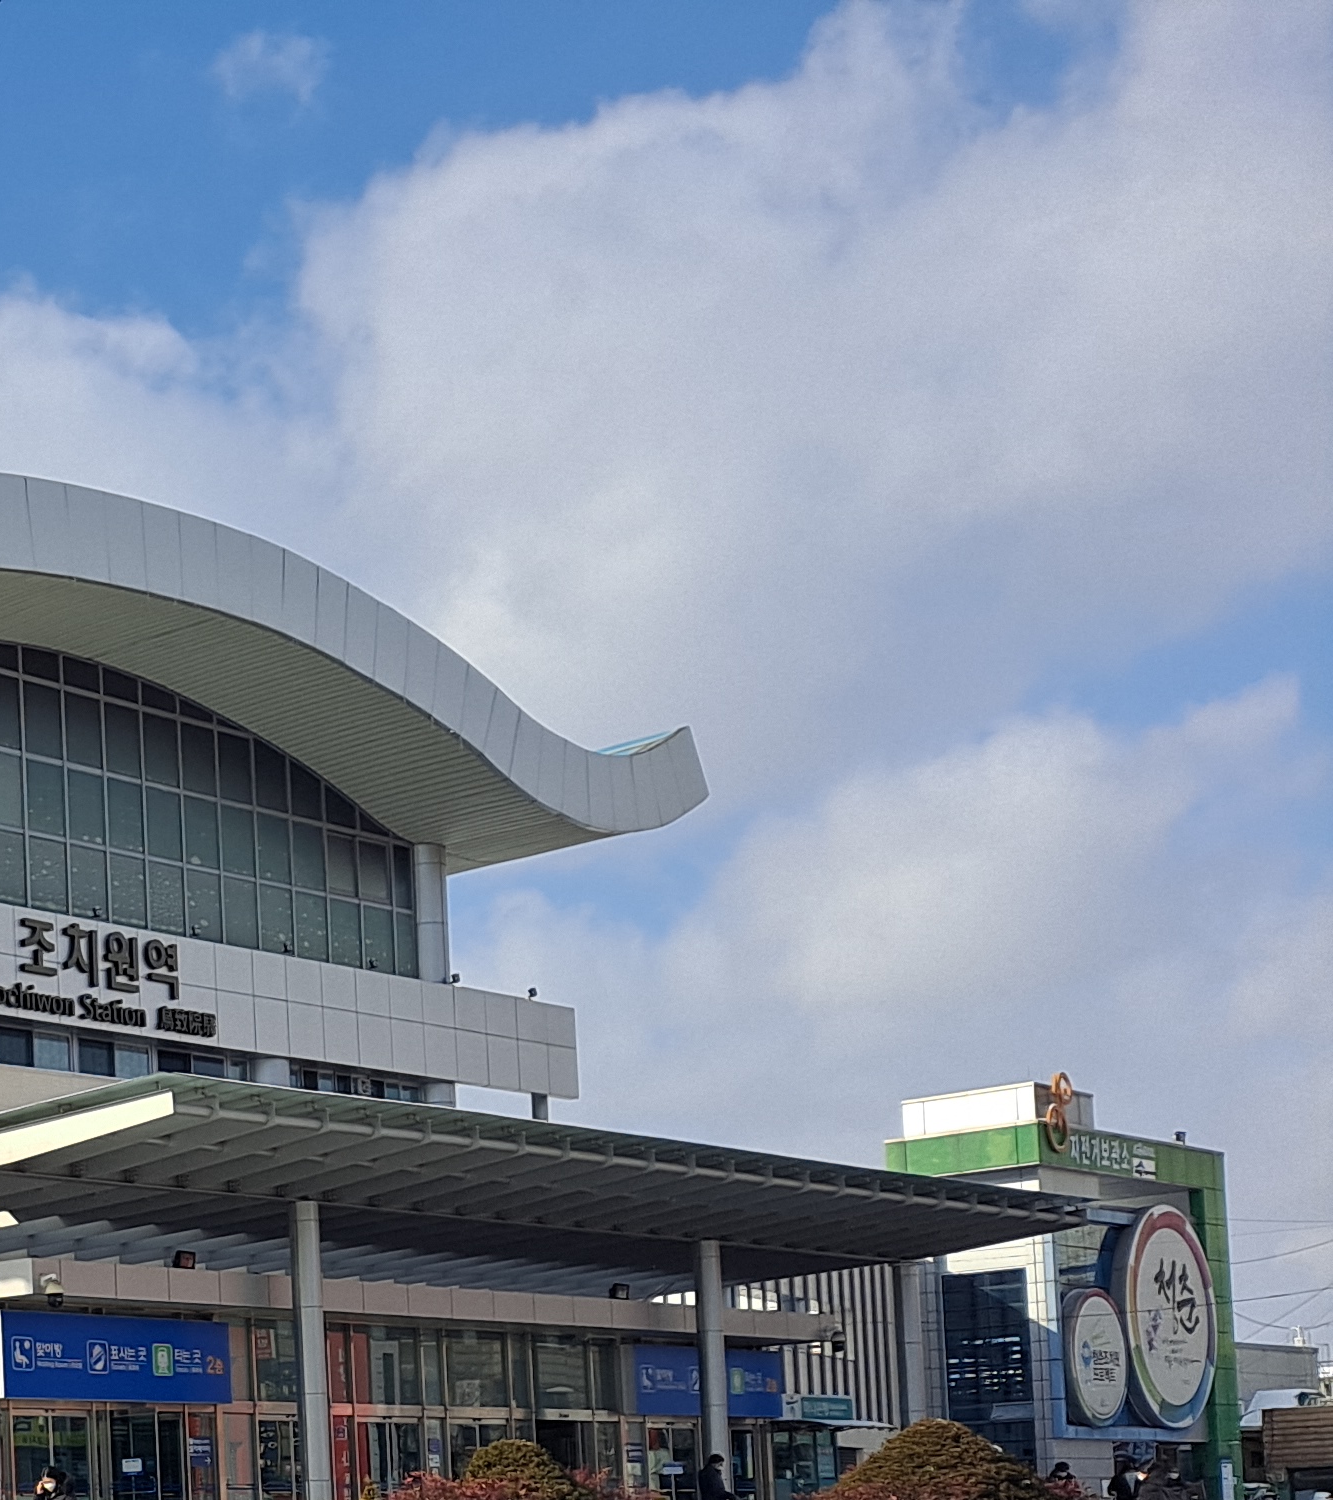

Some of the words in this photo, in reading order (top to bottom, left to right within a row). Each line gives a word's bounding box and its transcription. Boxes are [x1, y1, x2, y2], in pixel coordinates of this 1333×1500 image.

[19, 917, 180, 1000] 조치원역
[78, 993, 147, 1028] Station
[35, 1342, 63, 1358] 맞이방
[110, 1345, 136, 1361] 표사는
